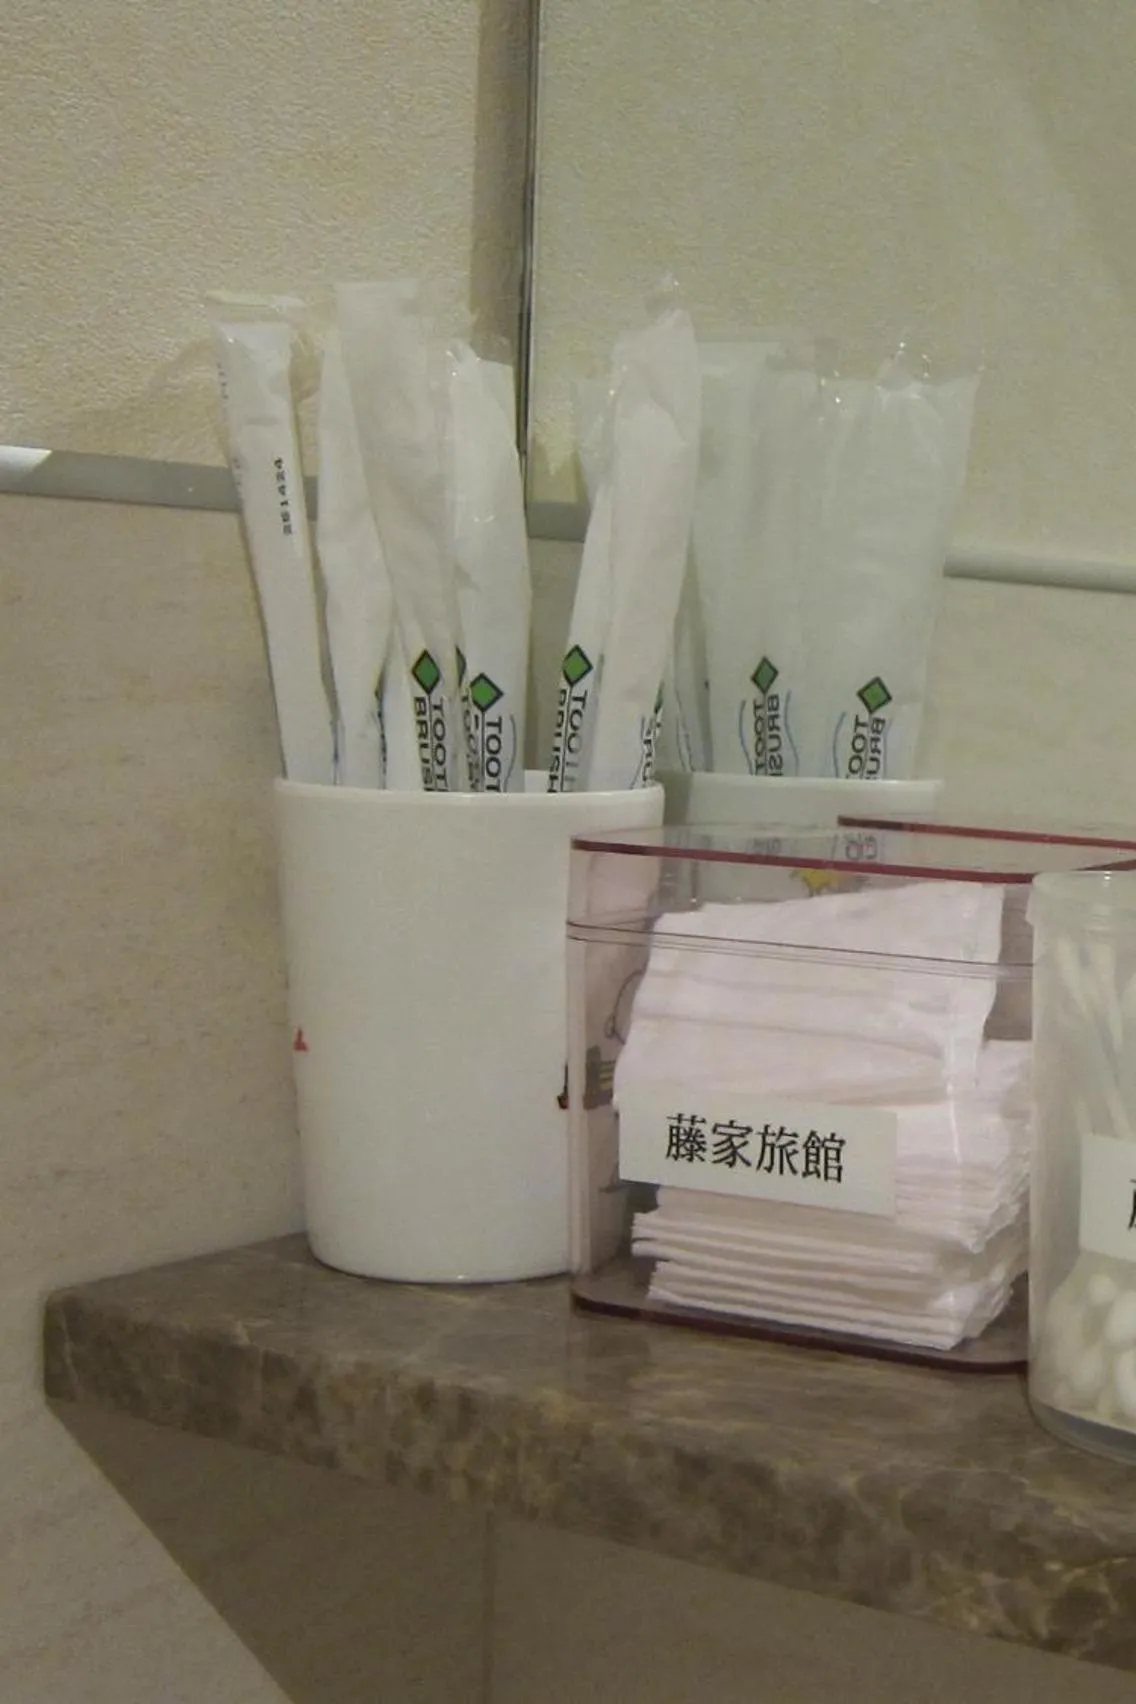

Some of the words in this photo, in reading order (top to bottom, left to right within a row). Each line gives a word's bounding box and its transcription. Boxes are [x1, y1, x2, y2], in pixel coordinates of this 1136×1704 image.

[414, 696, 434, 792] BRUS
[432, 696, 449, 792] TOOT
[664, 1113, 848, 1185] 藤家旅館
